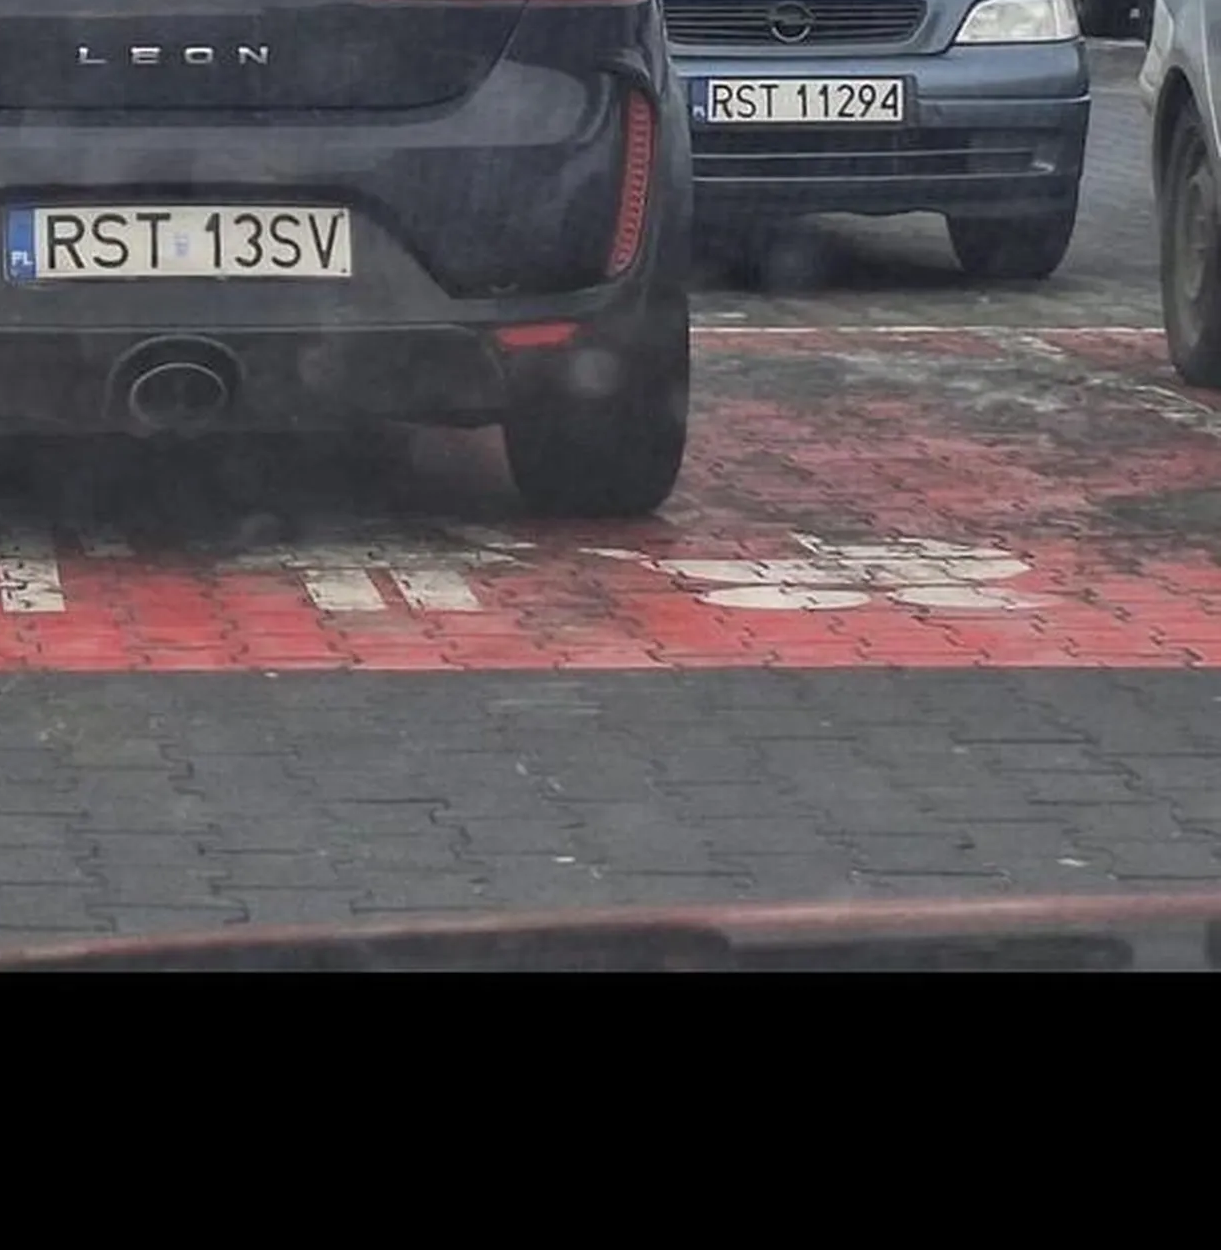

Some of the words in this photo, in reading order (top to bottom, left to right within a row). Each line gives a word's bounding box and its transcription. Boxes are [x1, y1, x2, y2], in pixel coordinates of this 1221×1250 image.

[79, 47, 269, 64] LEON
[712, 83, 779, 118] RST
[797, 83, 899, 118] 11294
[46, 213, 172, 270] RST
[205, 212, 339, 270] 13SV
[11, 250, 34, 266] PL
